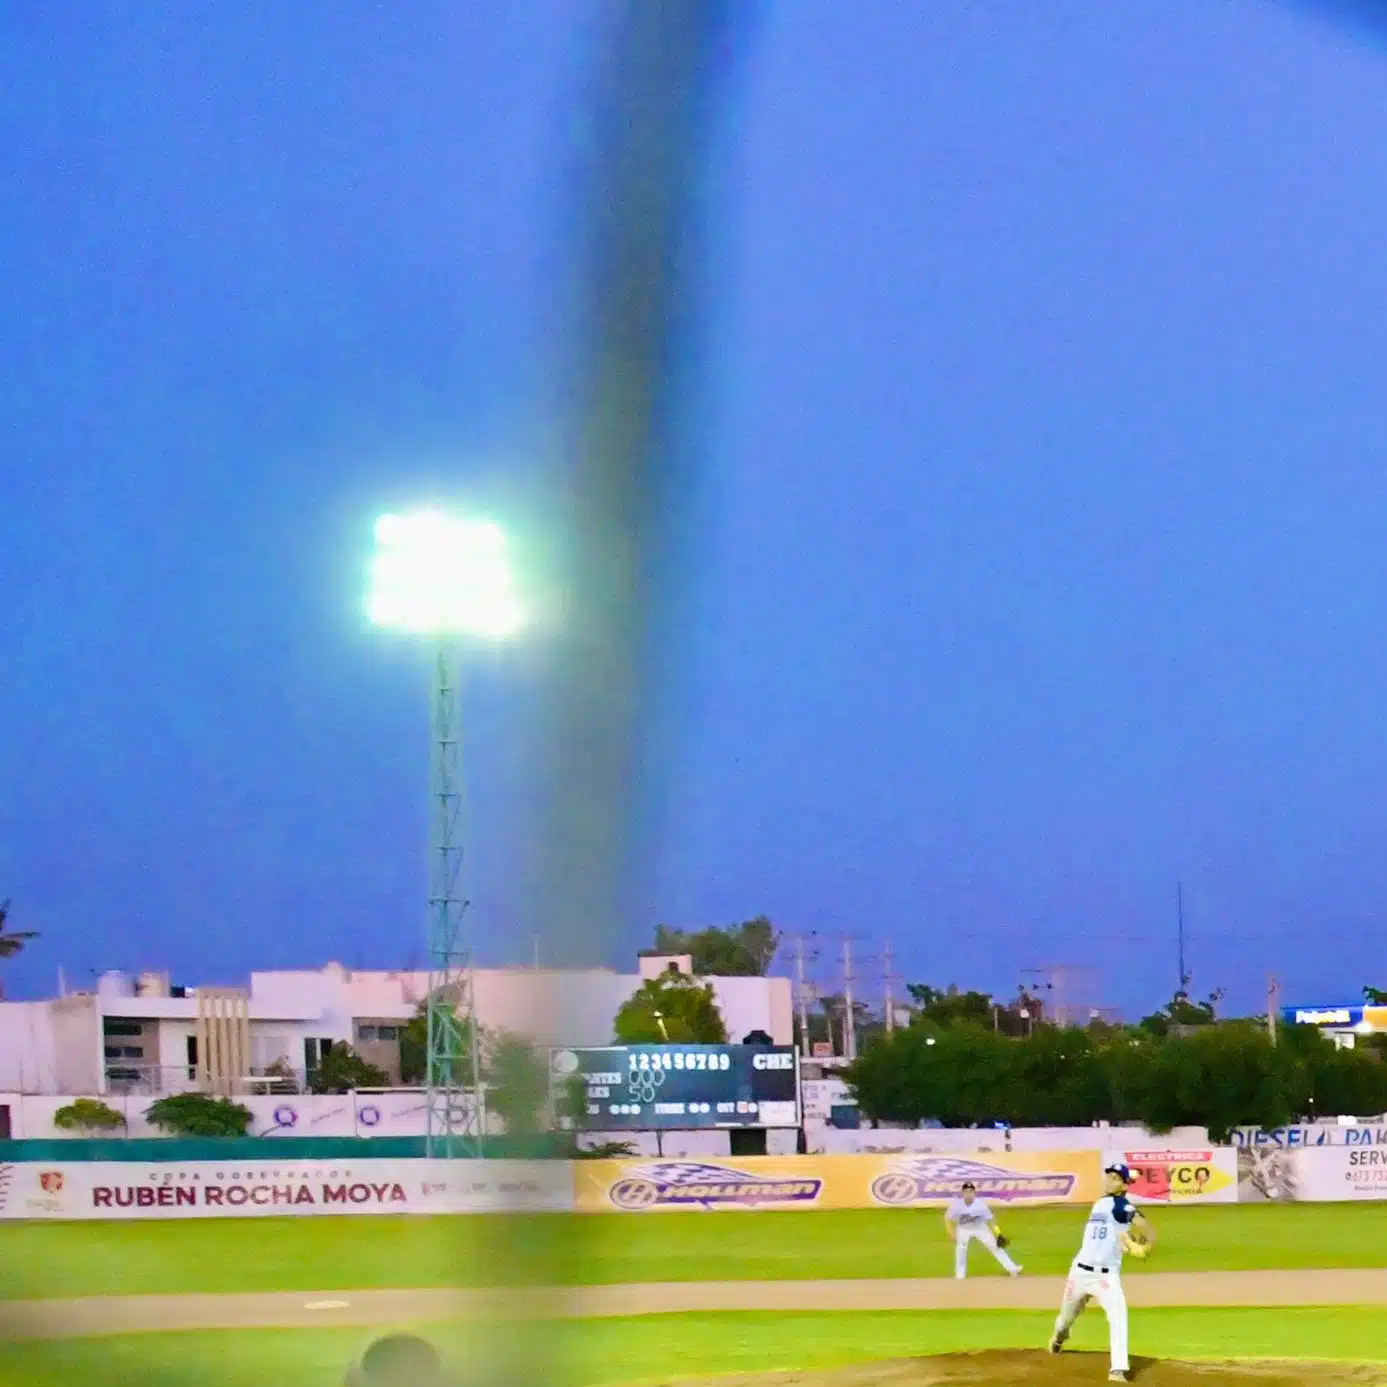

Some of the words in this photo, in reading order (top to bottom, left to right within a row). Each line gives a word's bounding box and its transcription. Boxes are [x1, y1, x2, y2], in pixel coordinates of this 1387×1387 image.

[92, 1181, 196, 1207] RUBÉN
[204, 1184, 315, 1206] ROCHA
[322, 1183, 408, 1204] MOYA
